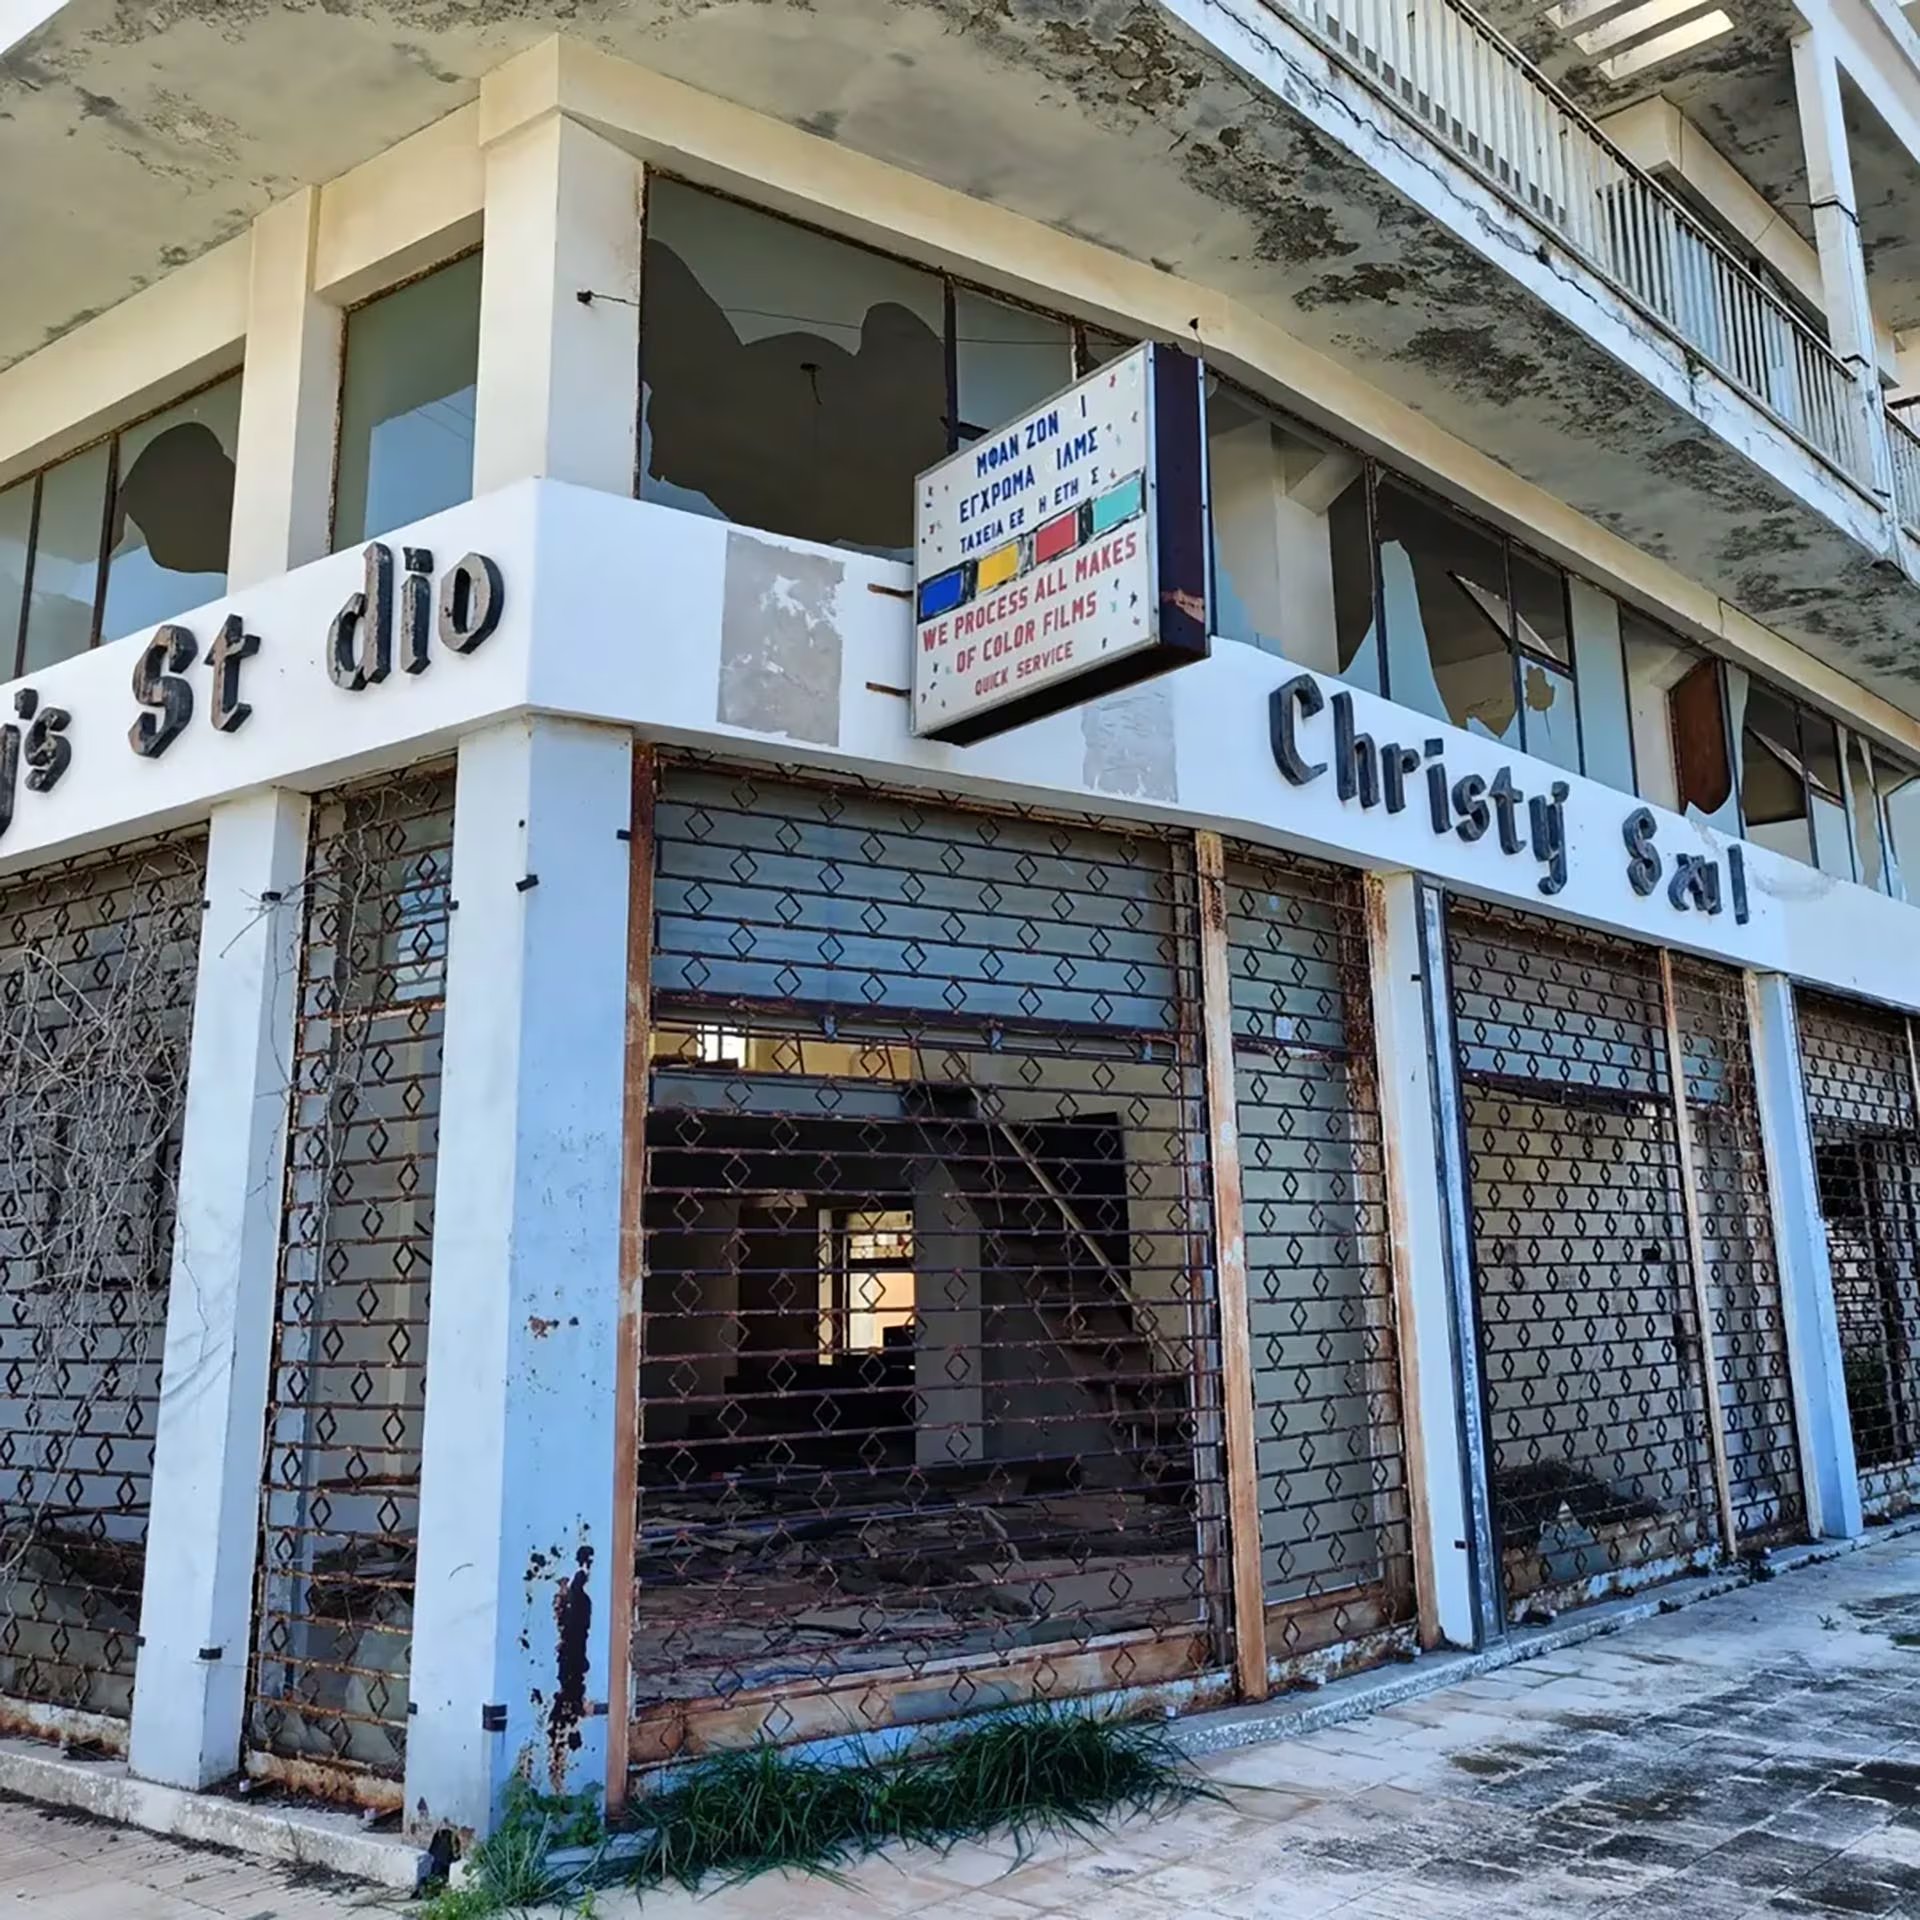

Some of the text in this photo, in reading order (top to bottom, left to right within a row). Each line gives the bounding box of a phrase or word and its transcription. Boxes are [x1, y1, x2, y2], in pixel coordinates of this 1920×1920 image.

[959, 465, 1035, 523] ΕΓΧΡΩΜΑ
[960, 520, 1004, 554] ΤΑΧΕΙΑ
[922, 532, 1137, 652] WE PROCESS ALL MAKES
[956, 591, 1097, 673] OF COLOR FILMS
[975, 641, 1073, 696] QUICK SERVICE
